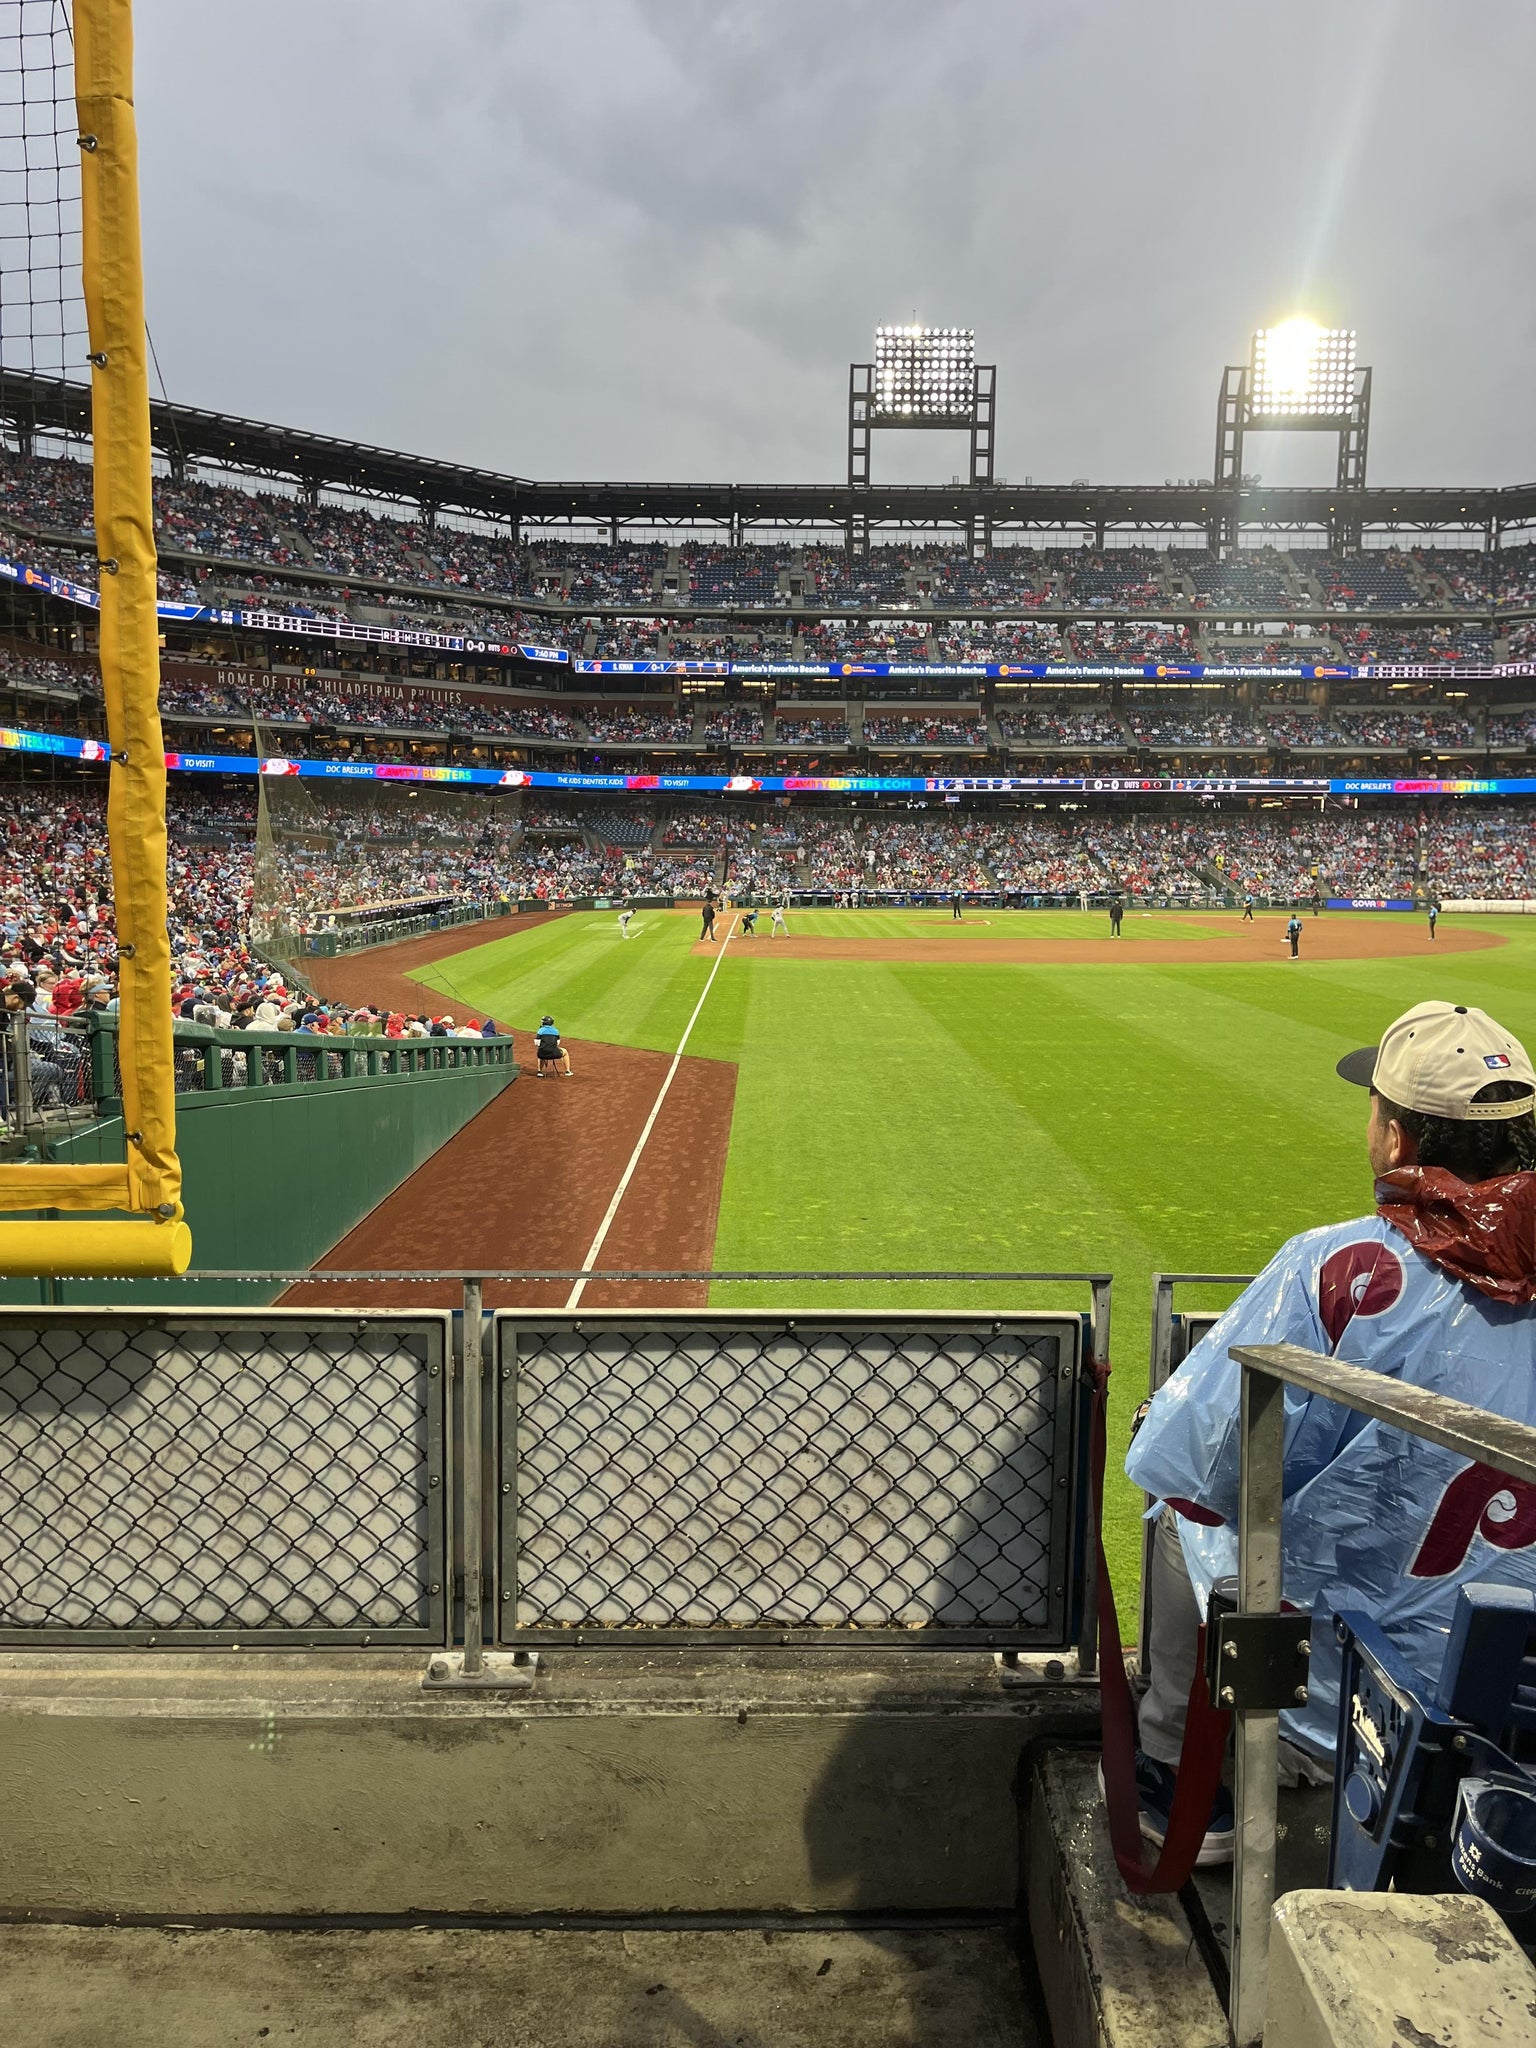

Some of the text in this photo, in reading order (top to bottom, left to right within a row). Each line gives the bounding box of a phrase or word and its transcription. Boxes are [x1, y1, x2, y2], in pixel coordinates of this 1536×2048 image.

[384, 632, 431, 644] R H E
[467, 640, 485, 652] 0-0
[488, 644, 500, 652] OUTS
[549, 650, 558, 658] PM
[732, 665, 829, 673] America's Favorite Beaches
[889, 666, 986, 674] America's Favorite Beaches
[1203, 668, 1301, 676] America's Favorite Beaches
[218, 671, 255, 686] HOME
[263, 675, 277, 689] OF
[286, 677, 308, 690] THE
[195, 760, 214, 768] VISIT!
[342, 766, 373, 775] BRESLER'S
[377, 766, 419, 778] CAVITY
[422, 768, 472, 780] BUSTERS
[628, 776, 659, 789] LOVE
[784, 779, 911, 789] CAVITYBUSTERS.COM
[1394, 782, 1438, 792] CAVITY
[1442, 782, 1497, 792] BUSTERS
[1459, 1856, 1475, 1880] Park
[1477, 1868, 1504, 1890] Bank
